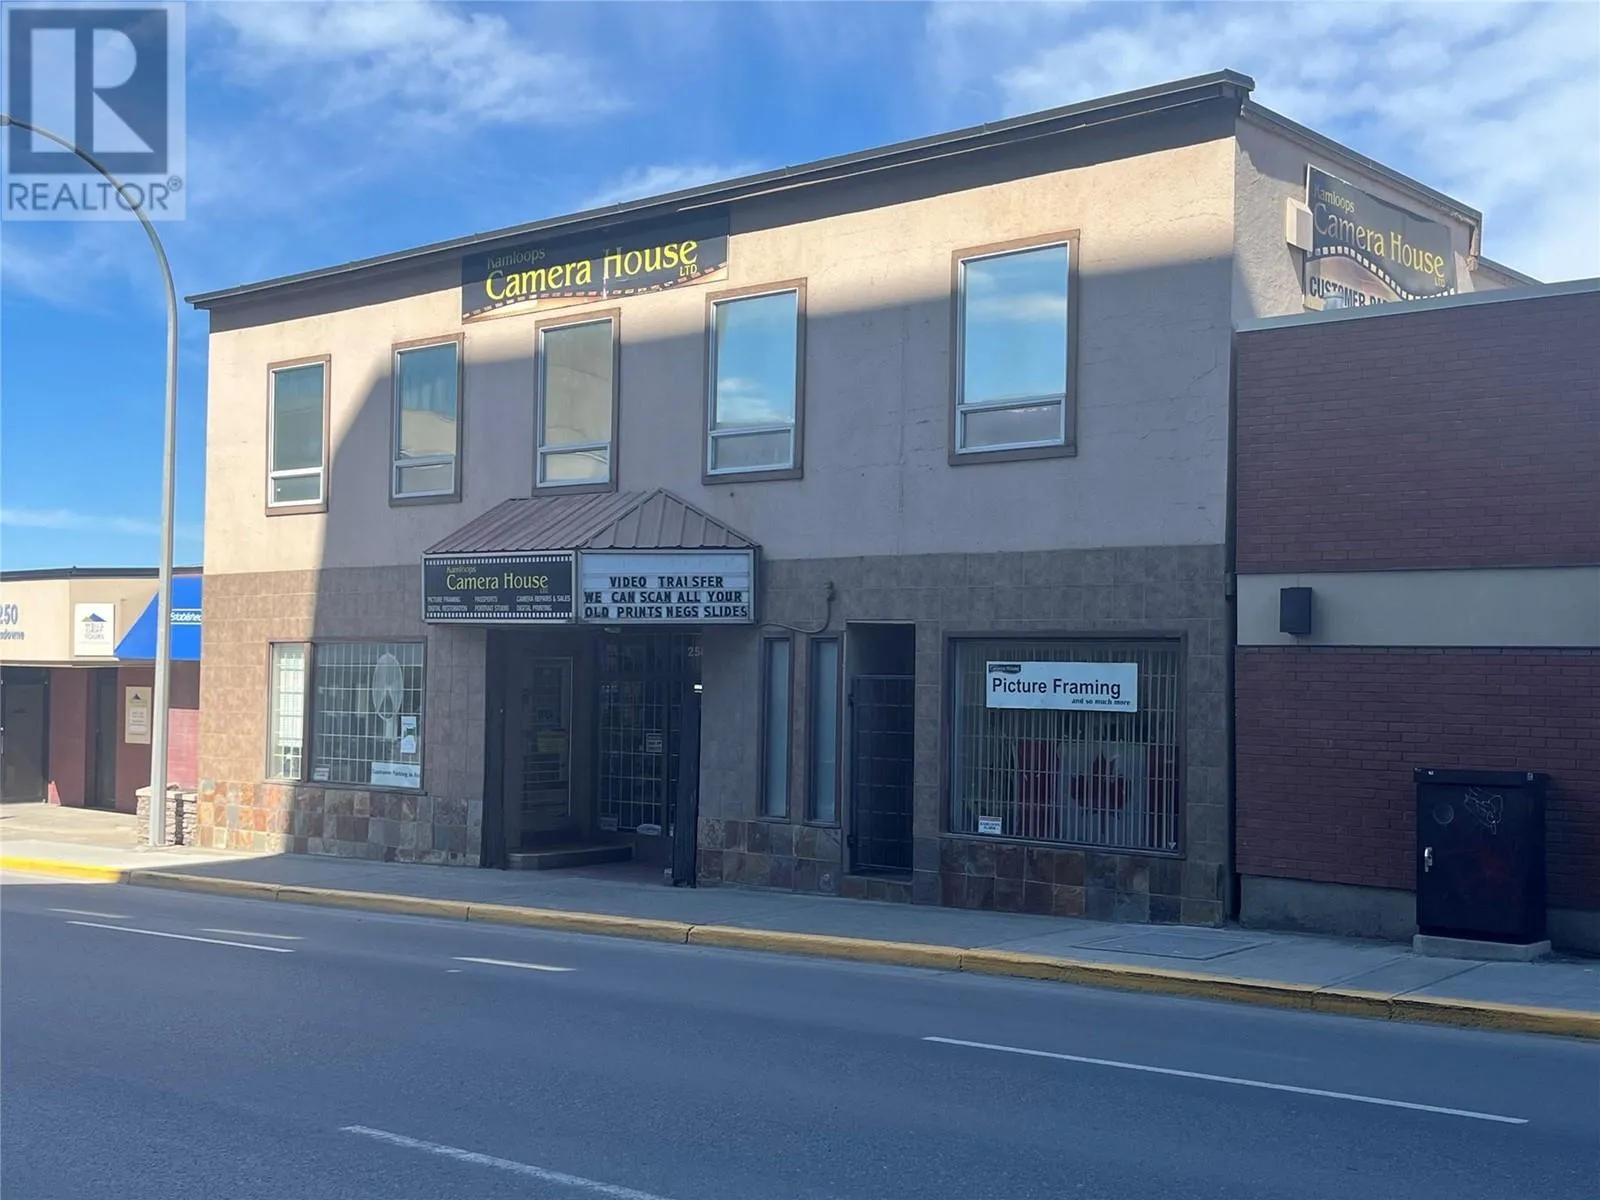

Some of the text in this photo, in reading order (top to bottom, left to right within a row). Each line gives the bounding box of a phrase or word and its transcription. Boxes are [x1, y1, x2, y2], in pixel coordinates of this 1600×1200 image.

[1314, 203, 1445, 278] Camera House
[487, 248, 546, 271] Kamloops
[486, 239, 698, 300] Camera House
[679, 264, 698, 278] LTD
[446, 572, 549, 591] Camera House
[609, 576, 647, 588] VIDEO
[584, 590, 743, 604] WE CAN SCAN ALL YOUR
[584, 606, 748, 618] OLD PRINTS NEGS SLIDES
[992, 677, 1121, 700] Picture Framing
